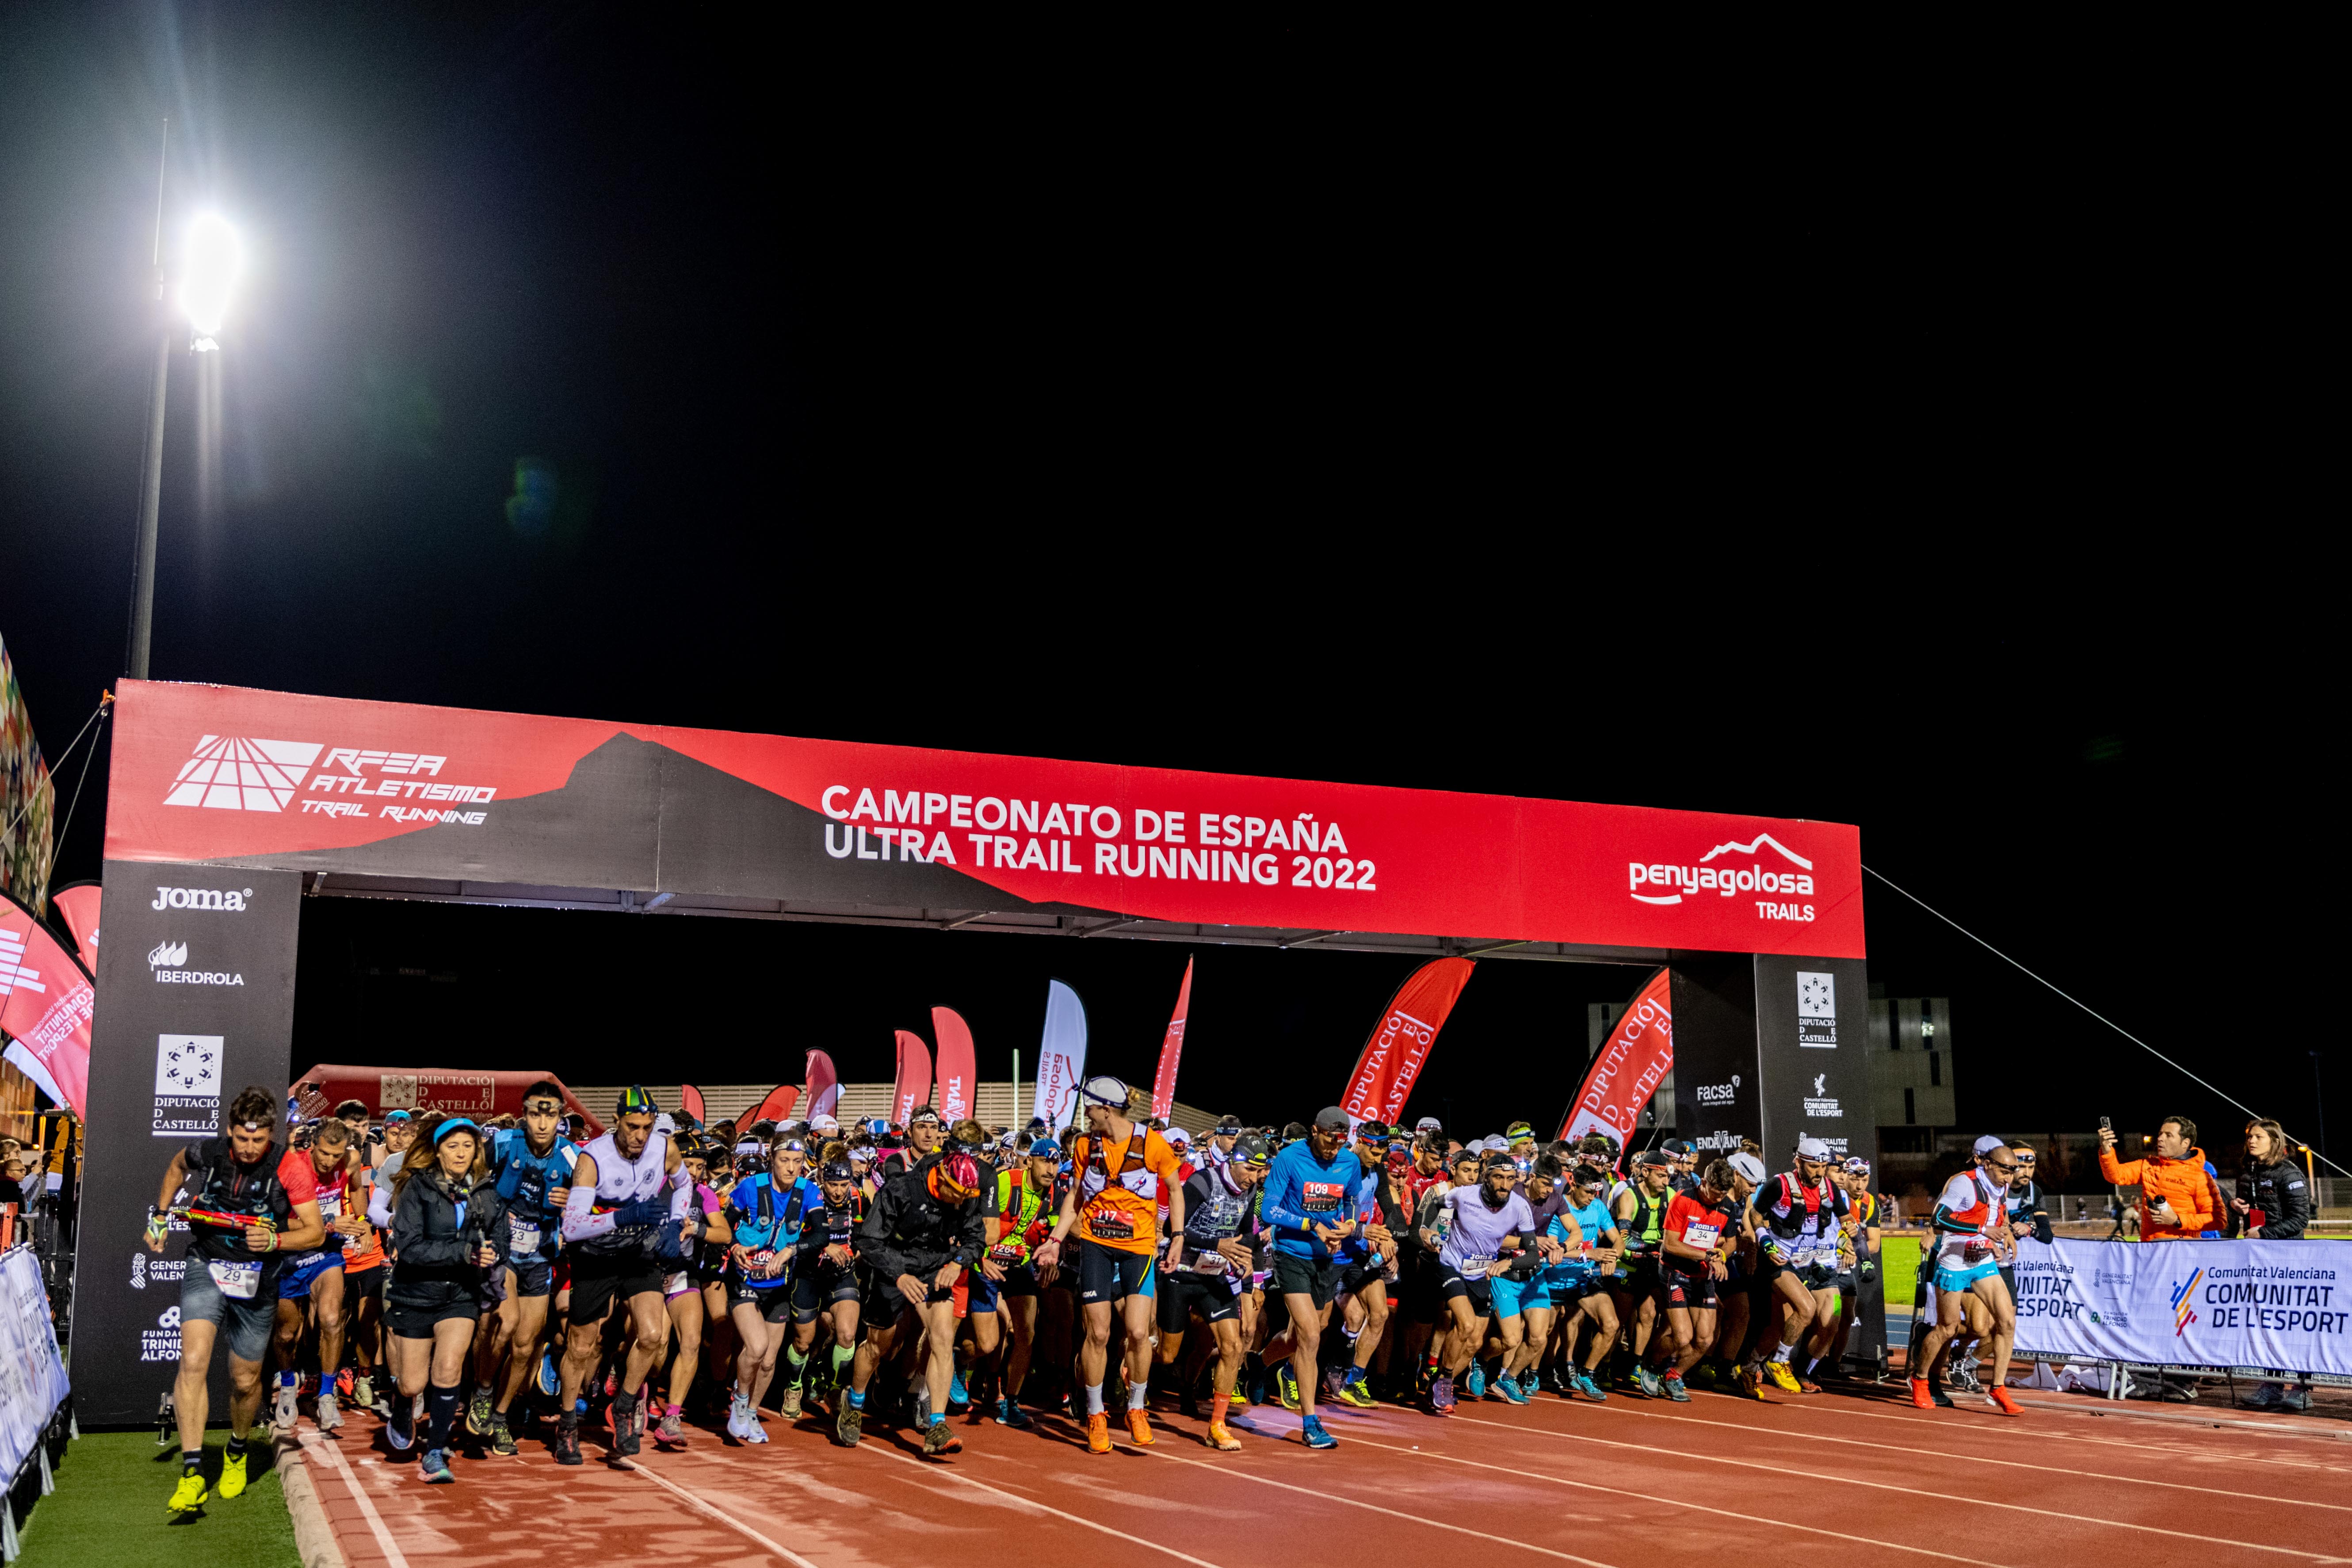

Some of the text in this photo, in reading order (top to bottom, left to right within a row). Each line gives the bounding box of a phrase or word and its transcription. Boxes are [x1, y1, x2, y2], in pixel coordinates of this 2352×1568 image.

[322, 748, 447, 776] RFEA
[310, 775, 497, 803] ATLETISMO
[302, 800, 487, 825] TRAIL RUNNING
[821, 785, 1348, 854] CAMPEONATO DE ESPAÑA
[825, 824, 1376, 891] ULTRA TRAIL RUNNING 2022
[1629, 863, 1813, 897] penyagolosa
[1756, 902, 1814, 922] TRAILS
[157, 970, 244, 985] IBERDROLA
[1402, 1023, 1417, 1037] E
[1799, 1018, 1836, 1026] DIPUTACIÓ
[1799, 1034, 1837, 1042] CASTELLÓ
[1347, 1017, 1401, 1114] DIPUTACIÓ
[1583, 1003, 1654, 1111] DIPUTACIÓ
[418, 1075, 490, 1085] DIPUTACIÓ
[1381, 1031, 1430, 1127] CASTELLÓ
[418, 1086, 490, 1098] D E
[155, 1096, 220, 1108] DIPUTACIÓ
[300, 1091, 323, 1113] CENARIO
[305, 1097, 328, 1119] PORTIVO
[417, 1098, 489, 1110] CASTELLÓ
[154, 1109, 219, 1118] D E
[1602, 1104, 1619, 1123] D
[153, 1119, 218, 1130] CASTELLÓ
[1696, 1130, 1743, 1155] ENDAVANT
[1309, 1183, 1328, 1194] 109
[1098, 1209, 1117, 1221] 117
[150, 1261, 187, 1270] GENER
[1210, 1256, 1221, 1265] 31
[150, 1271, 184, 1280] VALEN
[224, 1269, 241, 1282] 29
[2209, 1266, 2336, 1280] Comunitat Valenciana
[2206, 1284, 2333, 1307] COMUNITAT
[2016, 1298, 2084, 1320] ESPORT
[2213, 1308, 2348, 1334] DE L'ESPORT
